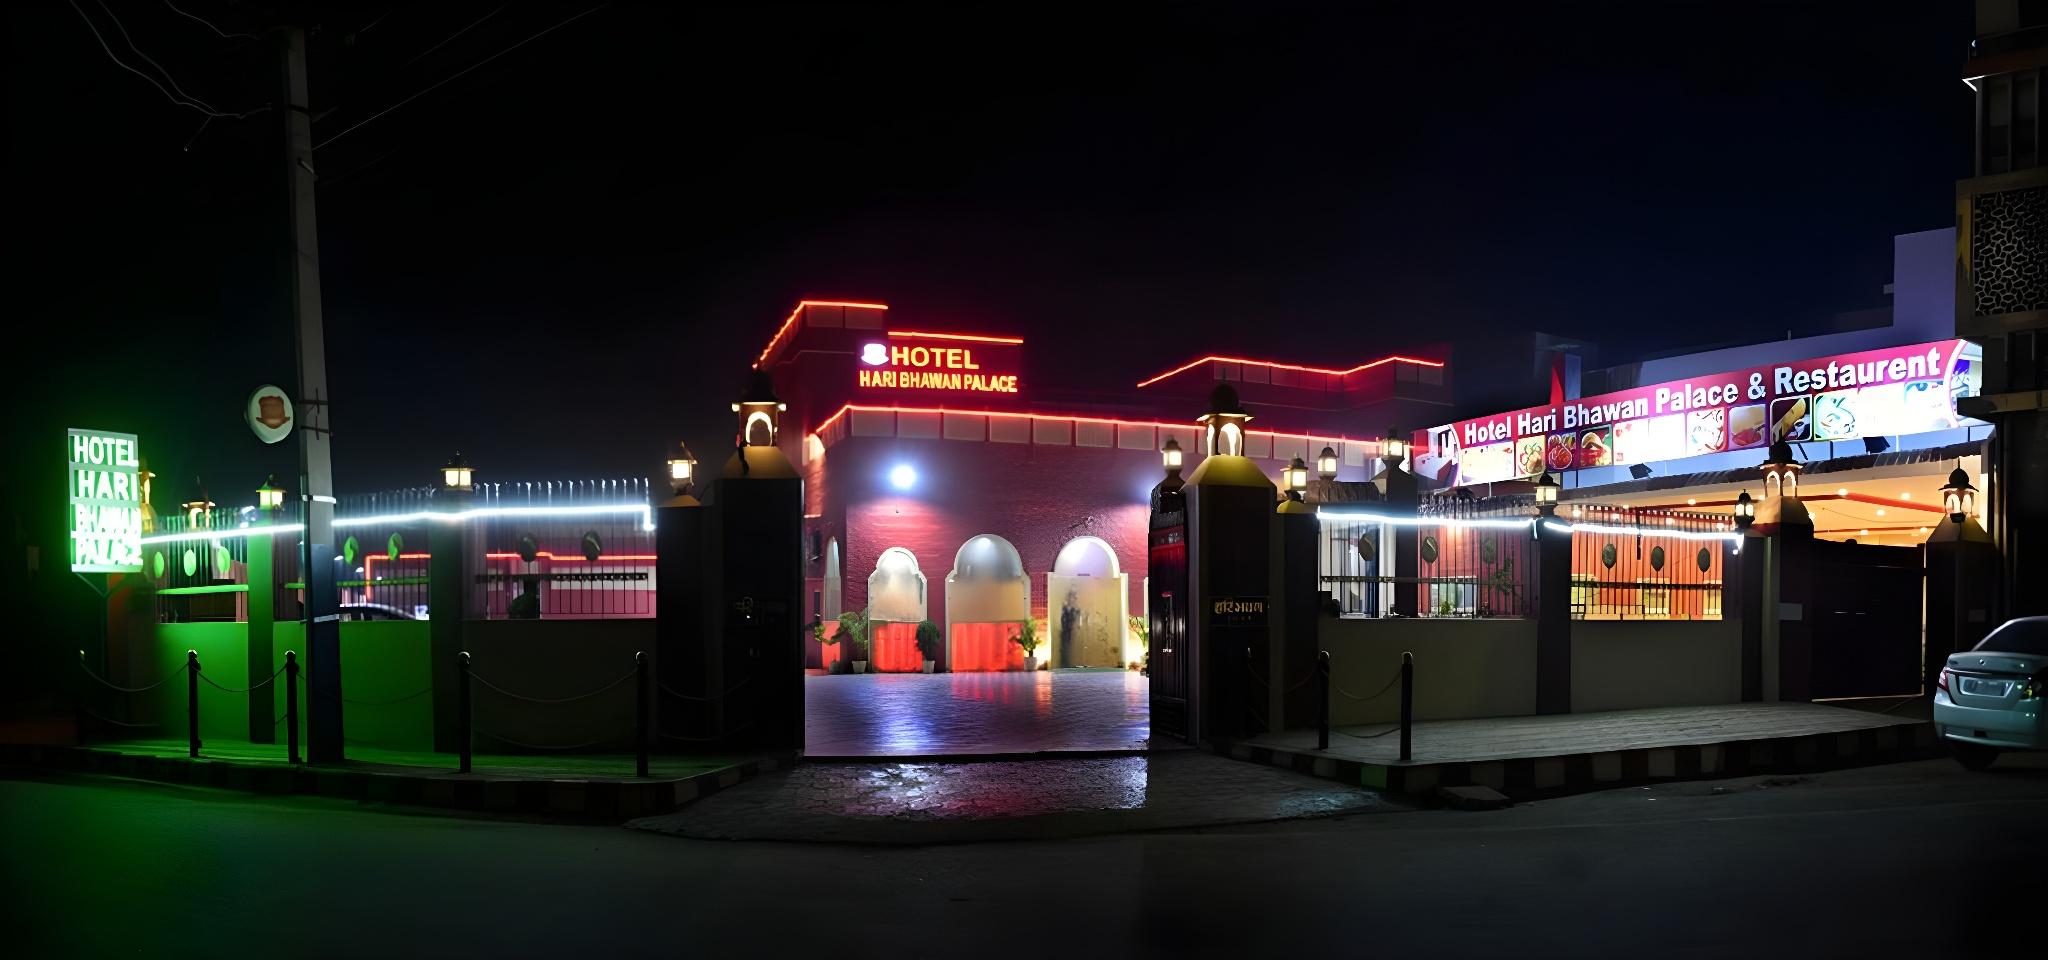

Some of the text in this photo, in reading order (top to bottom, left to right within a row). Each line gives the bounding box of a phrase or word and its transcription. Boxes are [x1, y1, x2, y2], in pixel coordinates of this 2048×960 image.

[891, 346, 979, 369] HOTEL
[859, 370, 1018, 393] HARI BHAWAN PALACE
[1465, 347, 1941, 445] Hotel Hari Bhawan Palace & Restaurent
[74, 435, 139, 466] HOTEL
[78, 470, 138, 501] HARI
